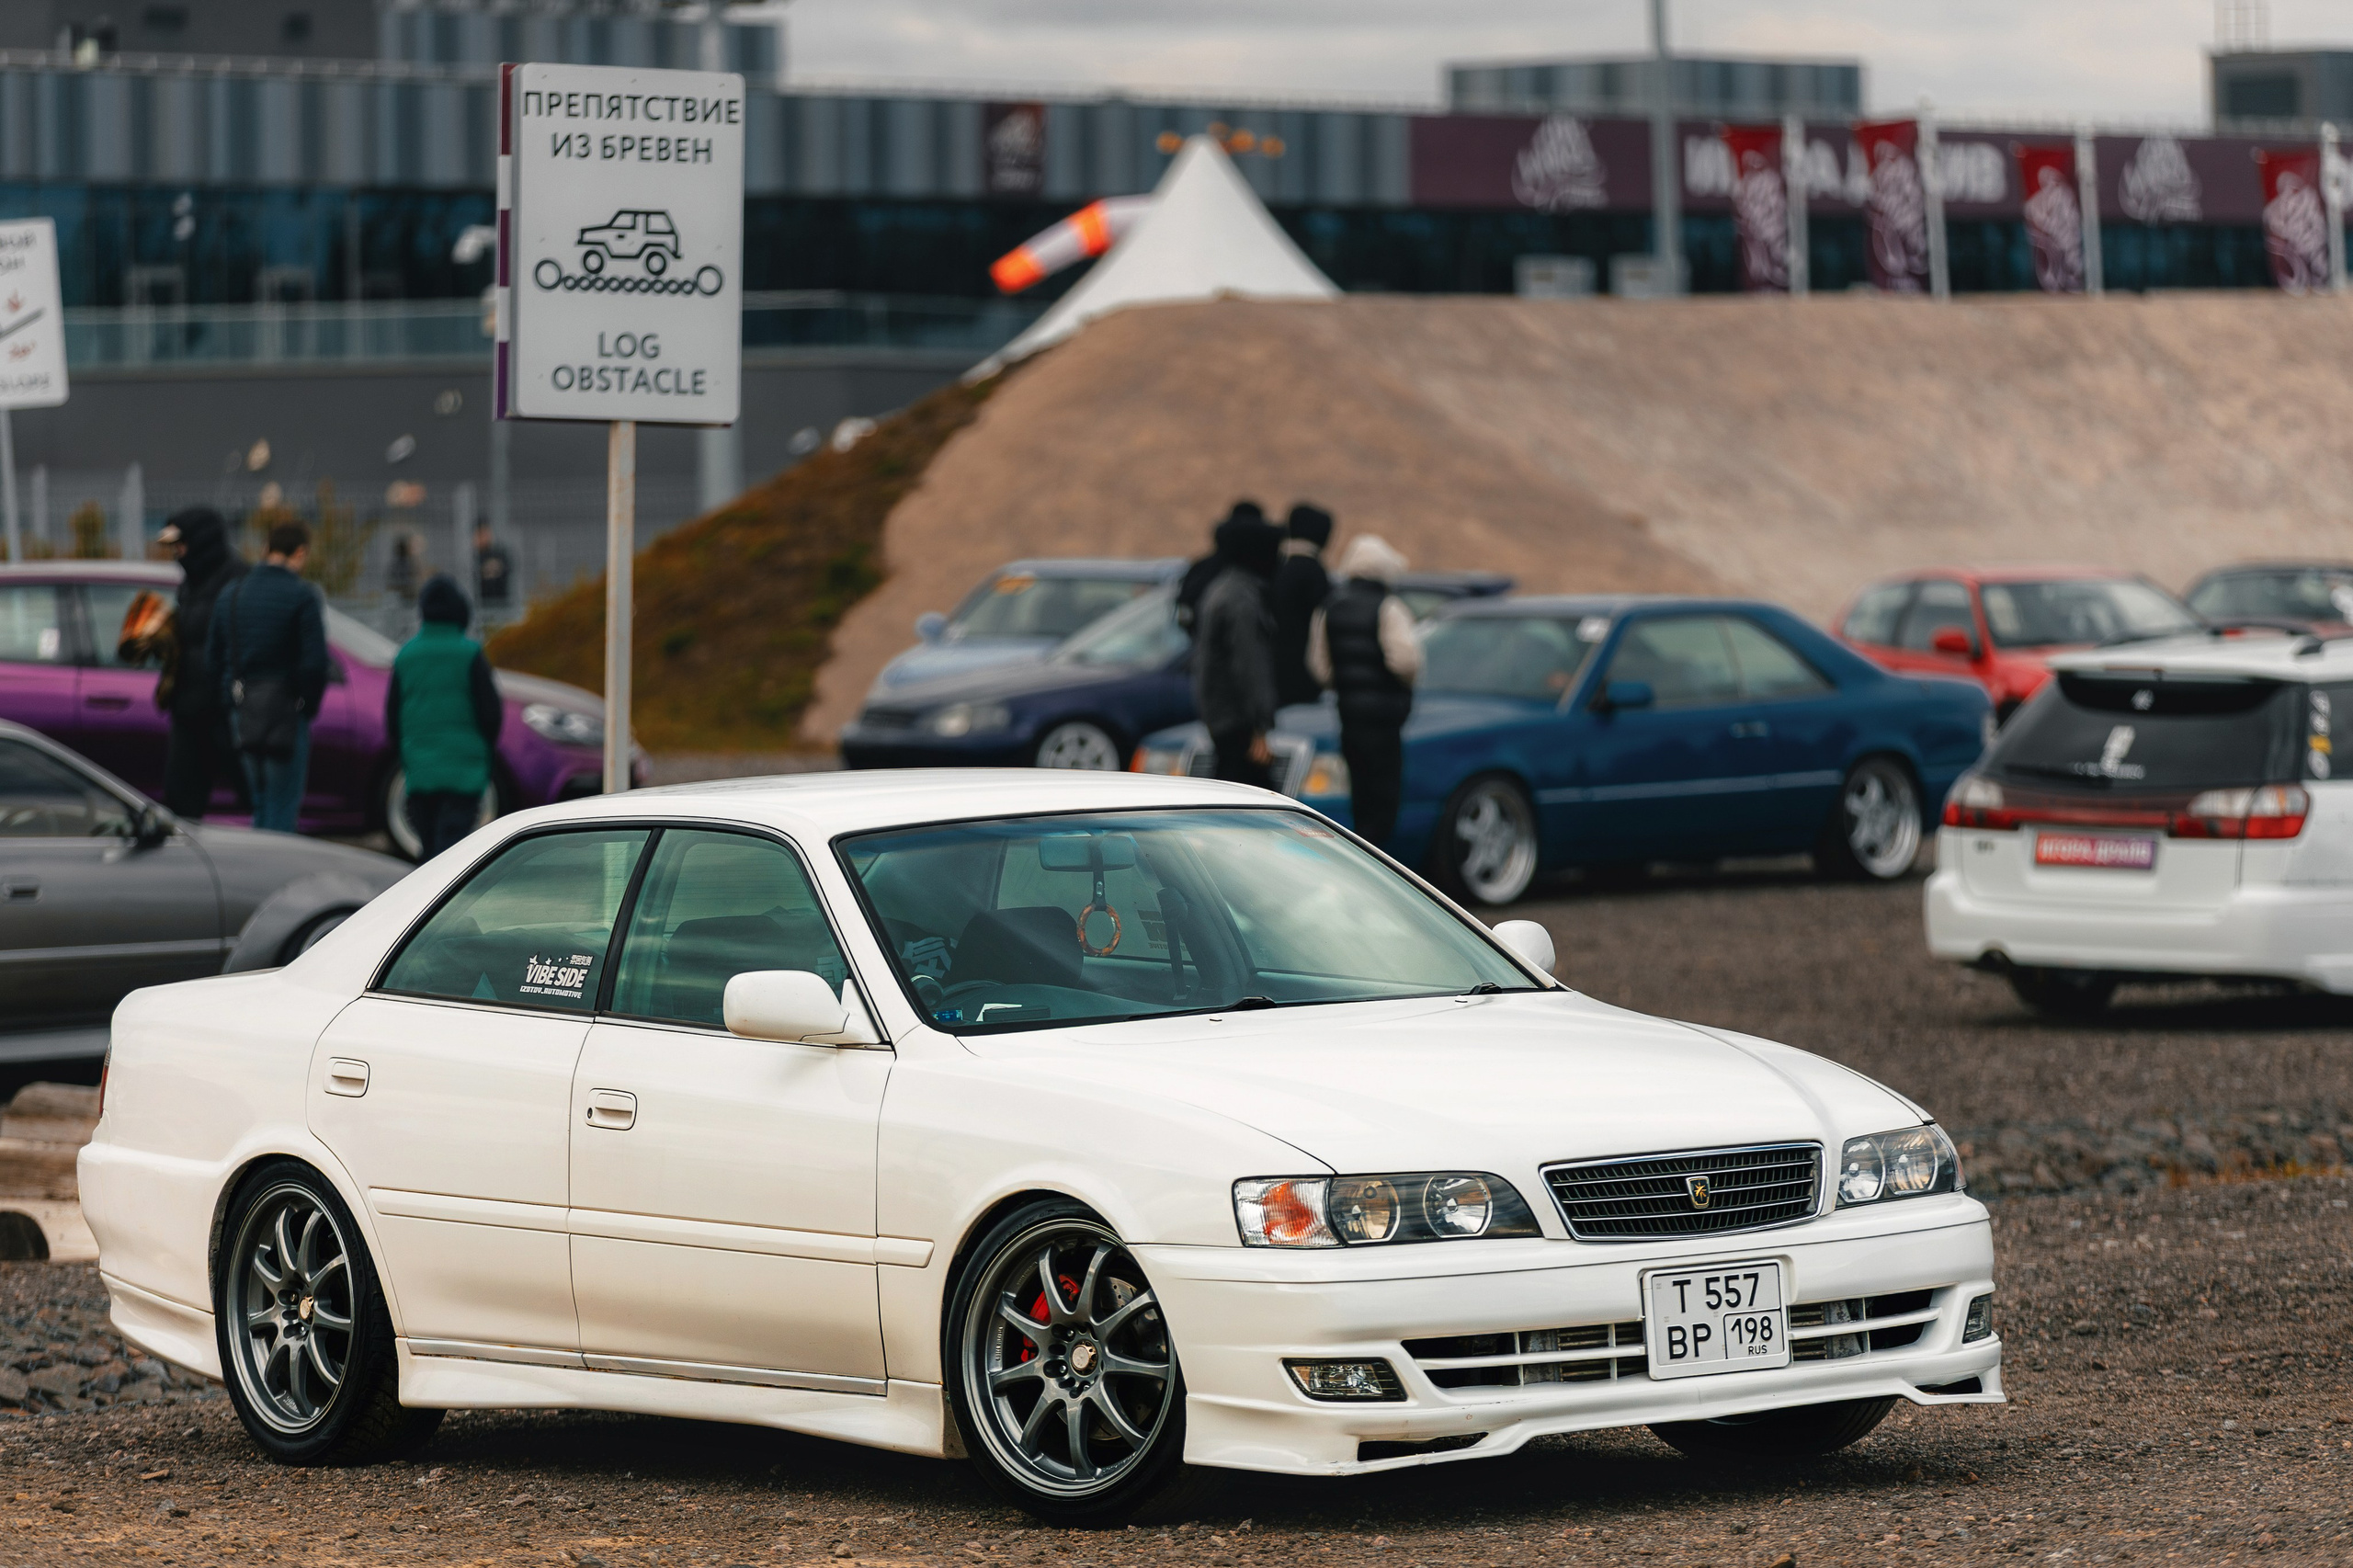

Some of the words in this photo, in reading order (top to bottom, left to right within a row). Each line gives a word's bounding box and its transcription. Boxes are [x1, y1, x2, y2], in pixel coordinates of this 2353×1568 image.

[523, 90, 741, 124] ПРЕПЯТСТВИЕ
[551, 132, 592, 159] ИЗ
[600, 135, 713, 165] БРЕВЕН
[598, 331, 661, 359] LOG
[551, 364, 707, 395] OBSTACLE
[526, 964, 558, 985] VIBE
[553, 967, 588, 988] SIDE
[1672, 1278, 1692, 1313] Т
[1704, 1272, 1759, 1311] 557
[1667, 1323, 1711, 1359] ВР
[1731, 1316, 1773, 1344] 198
[1747, 1345, 1768, 1356] RUS
